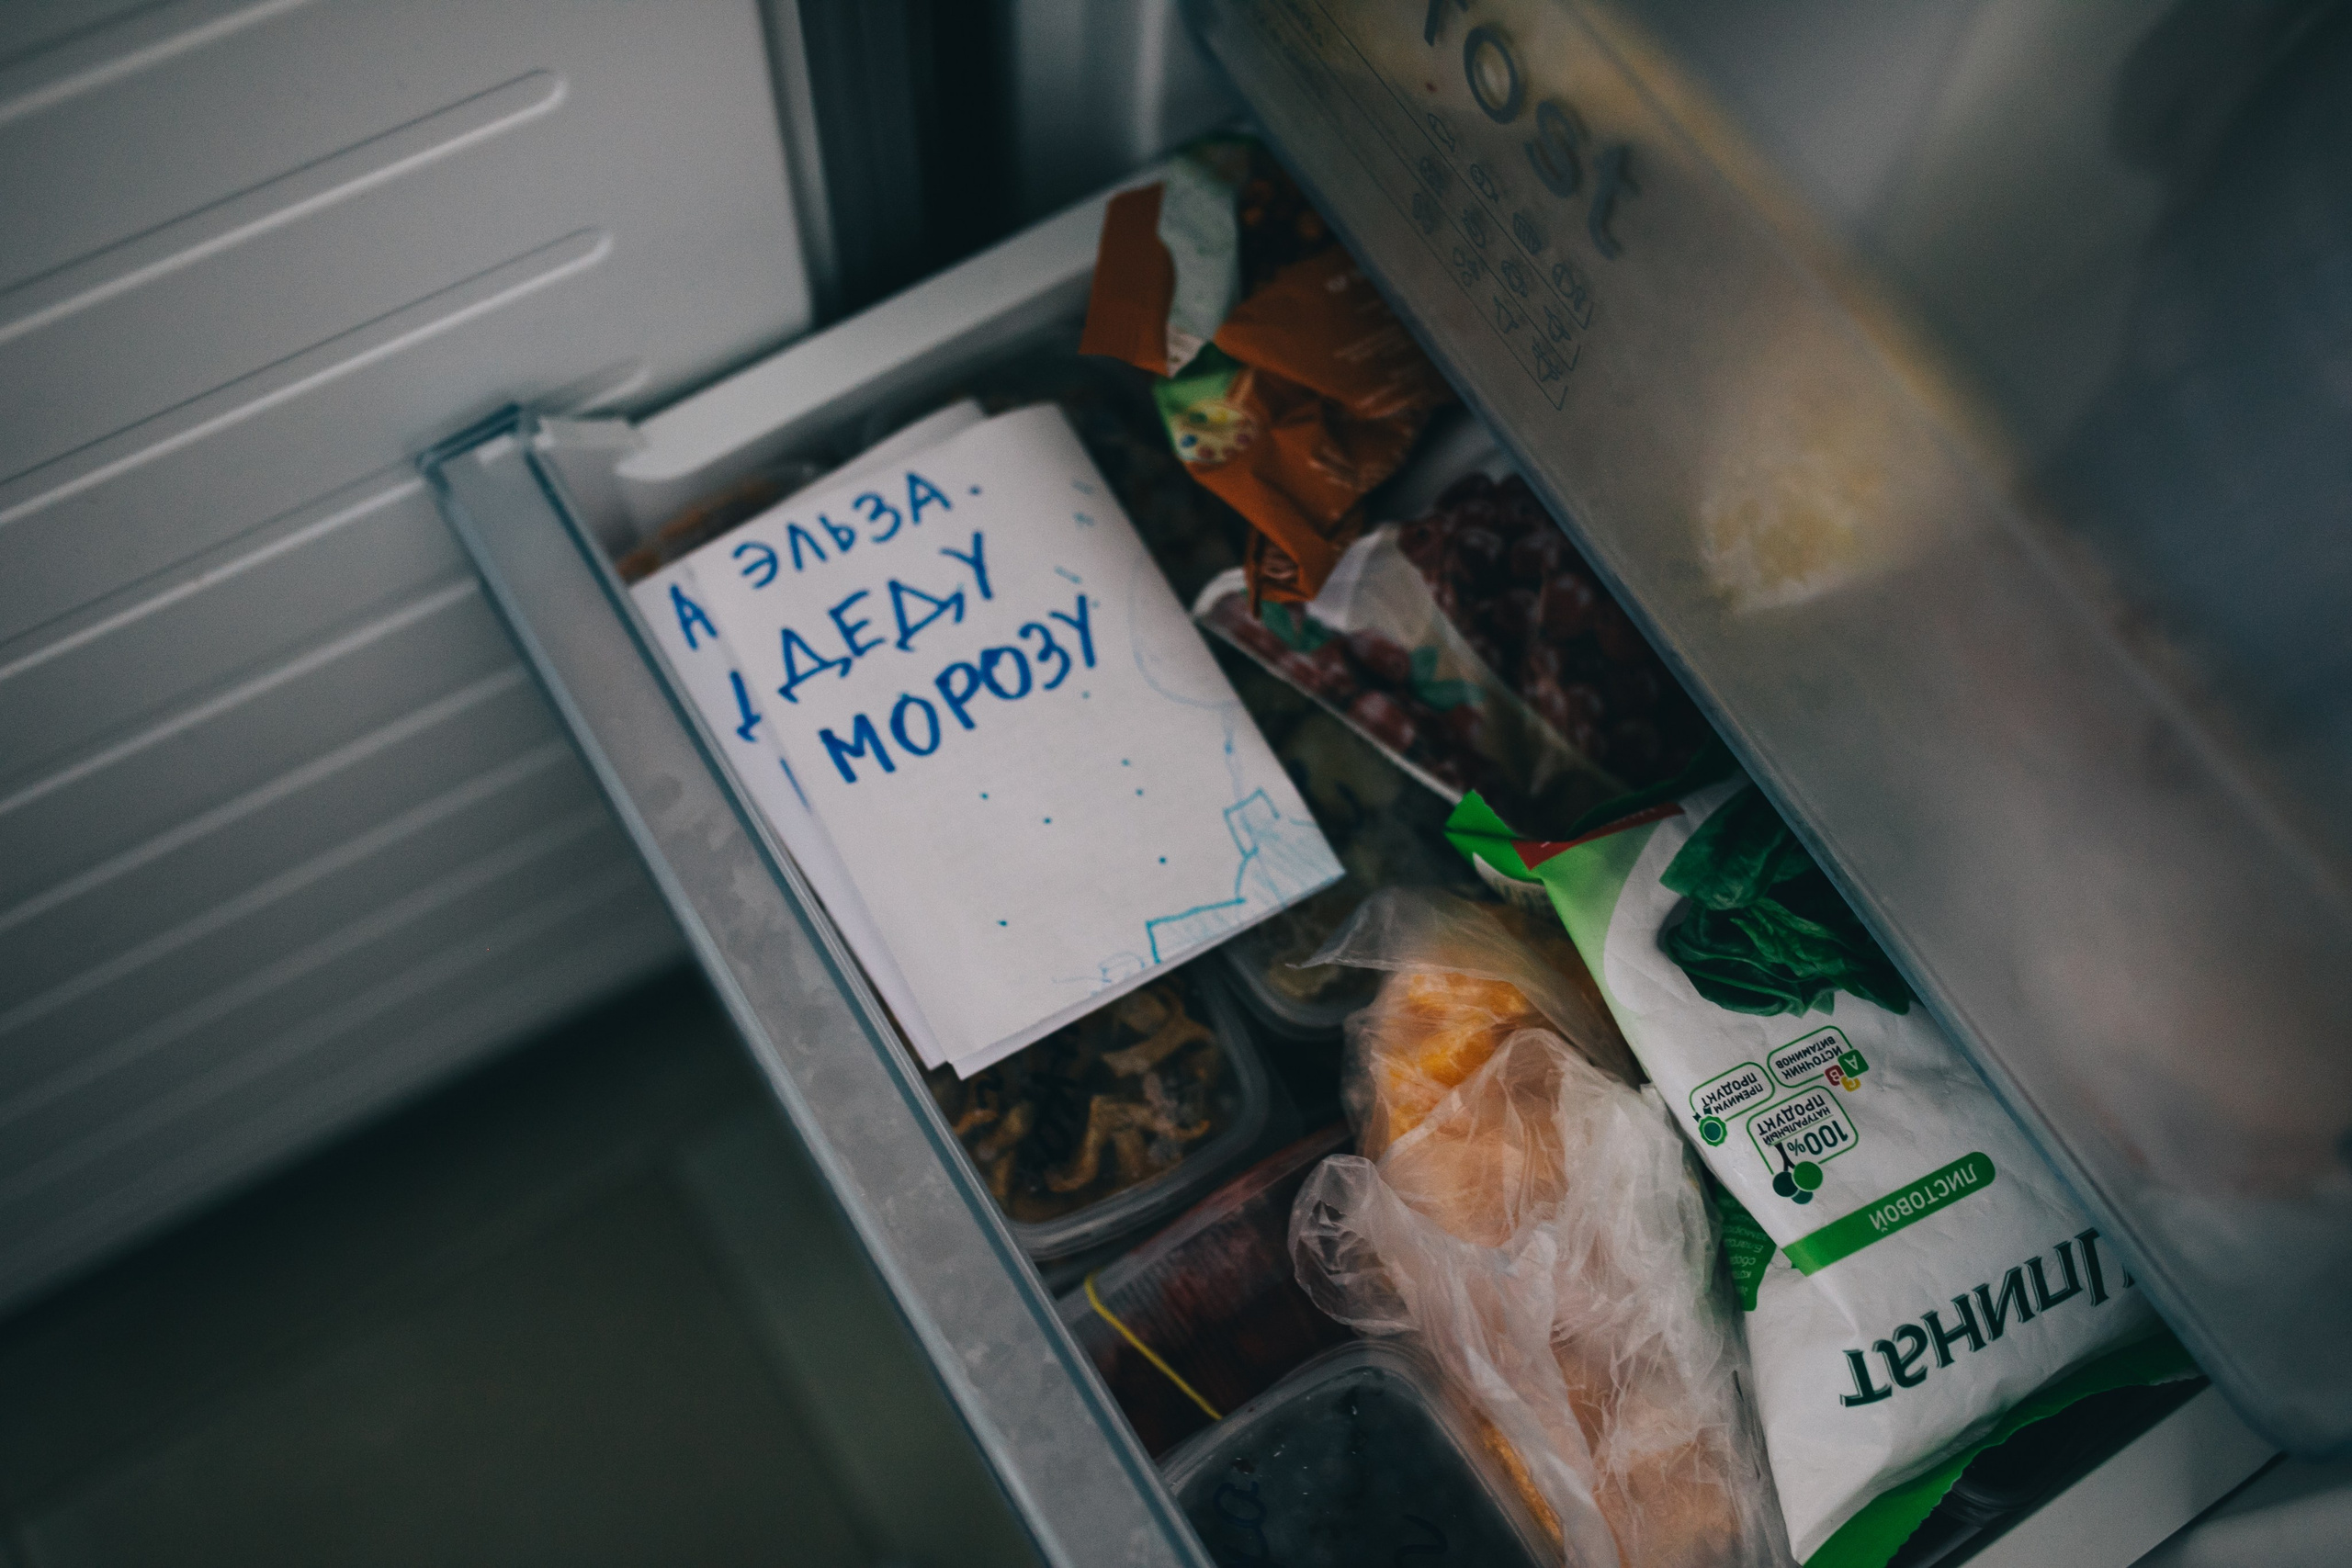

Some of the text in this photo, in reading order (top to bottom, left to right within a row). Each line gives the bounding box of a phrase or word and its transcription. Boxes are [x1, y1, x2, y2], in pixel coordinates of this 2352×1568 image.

[777, 531, 994, 704] ДЕДУ
[818, 594, 1099, 784] МОРОЗУ
[1774, 1035, 1837, 1069] ВИТАМИНОВ
[1781, 1045, 1843, 1080] ИСТОЧНИК
[1701, 1072, 1758, 1108] ПРОДУКТ
[1713, 1083, 1764, 1114] ПРЕМИУМ
[1756, 1094, 1826, 1135] ПРОДУКТ
[1761, 1106, 1831, 1146] НАТУРАЛЬНЫЙ
[1786, 1120, 1849, 1156] 100%
[1868, 1161, 1979, 1233] ЛИСТОВОЙ
